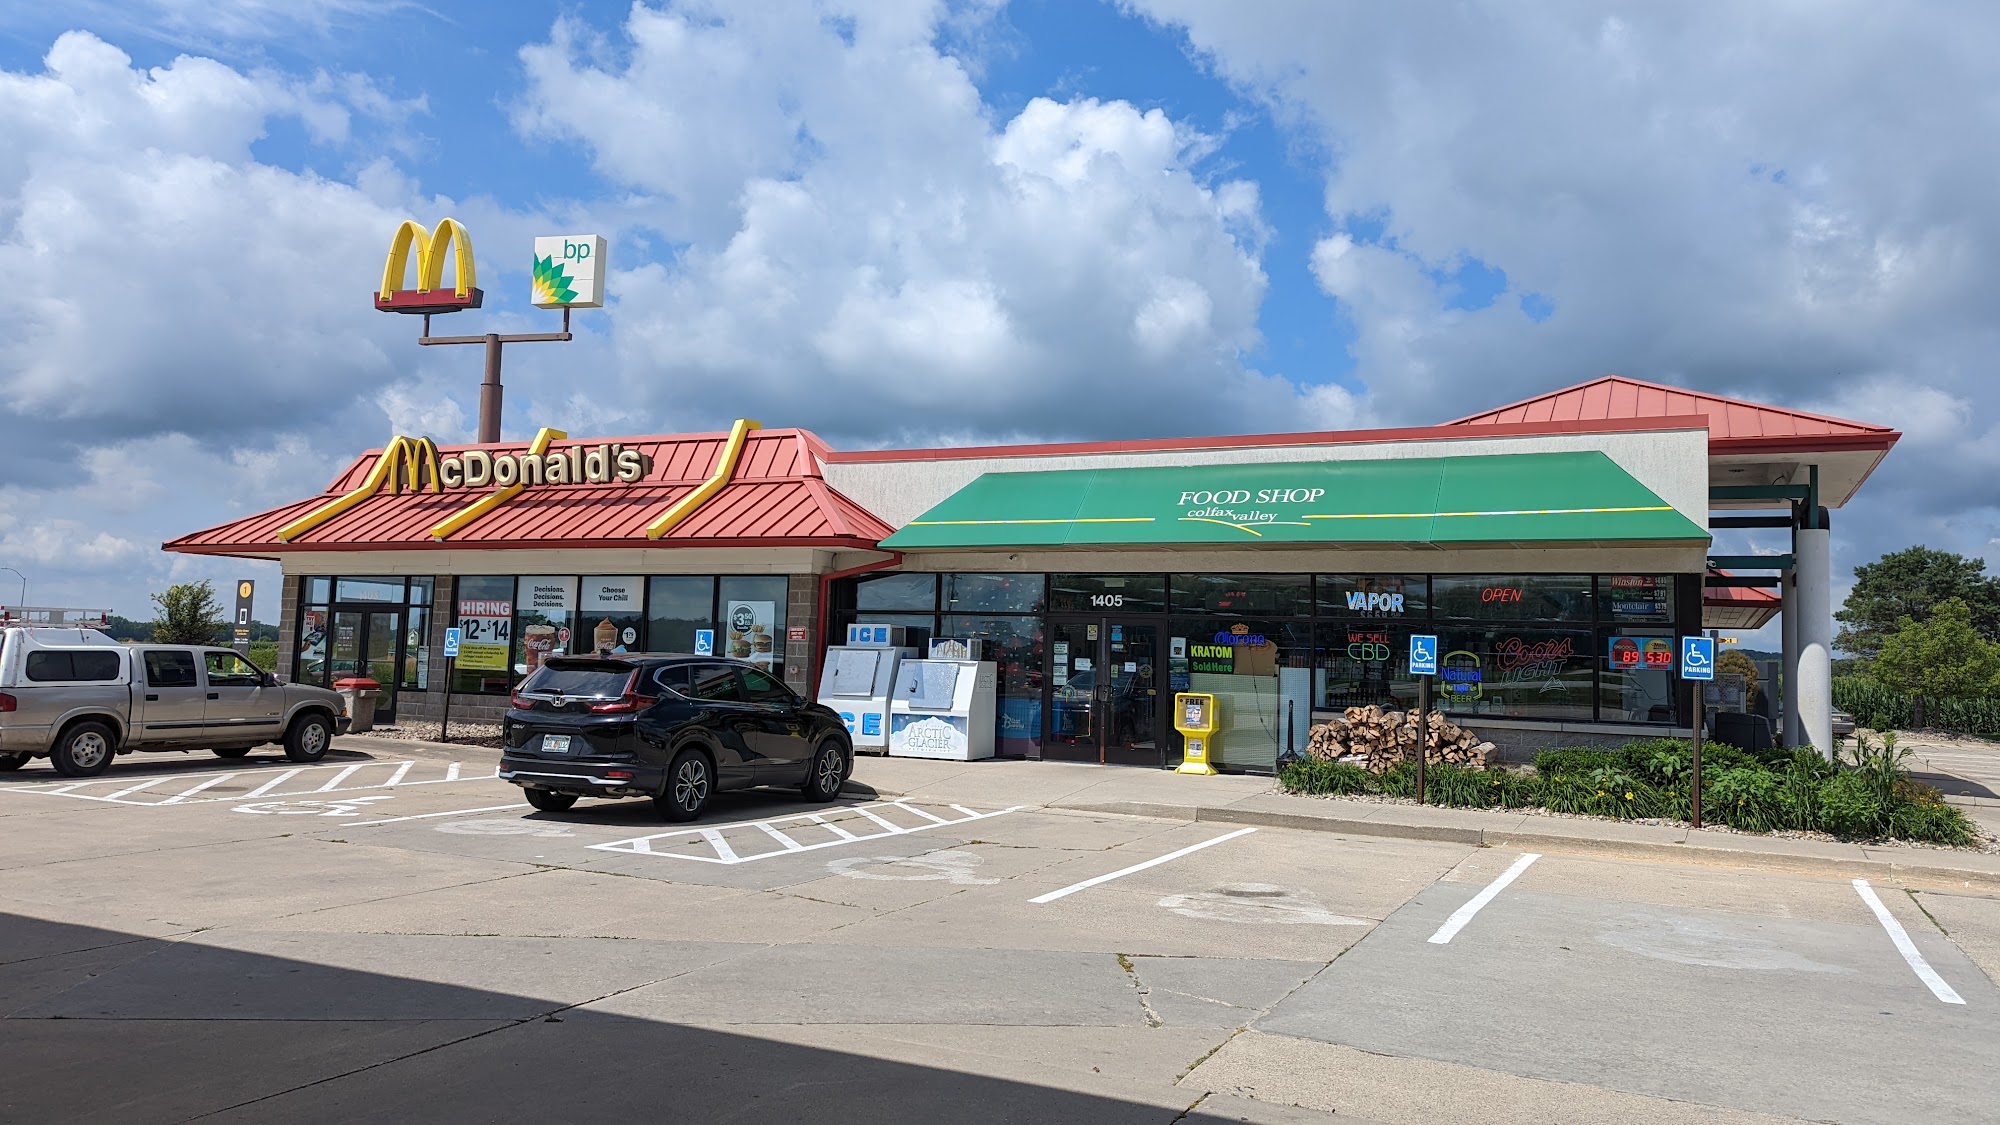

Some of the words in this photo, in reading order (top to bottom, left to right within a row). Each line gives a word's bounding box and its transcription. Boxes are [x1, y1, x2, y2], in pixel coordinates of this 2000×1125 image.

[563, 239, 591, 264] bp
[390, 436, 644, 495] McDonald's
[1177, 490, 1251, 505] FOOD
[1255, 488, 1325, 504] SHOP
[1187, 507, 1234, 517] colfax
[1232, 510, 1278, 522] valley
[1612, 576, 1644, 586] Winston
[1090, 594, 1123, 607] 1405
[1346, 591, 1404, 612] VAPOR
[1482, 588, 1524, 602] OPEN
[460, 601, 510, 616] HIRING
[1612, 602, 1650, 610] Montclair
[850, 626, 887, 642] ICE
[1214, 631, 1265, 646] Corona
[1348, 633, 1364, 642] WE
[1366, 634, 1390, 644] SELL
[1190, 645, 1232, 658] KRATOM
[1348, 642, 1390, 660] CBD
[1496, 637, 1574, 672] Coors
[1192, 662, 1211, 672] Sold
[1212, 662, 1232, 672] Here
[1441, 666, 1482, 682] Natural
[1500, 658, 1568, 688] LIGHT
[908, 724, 952, 740] ARCTIC
[908, 738, 951, 750] GLACIER
